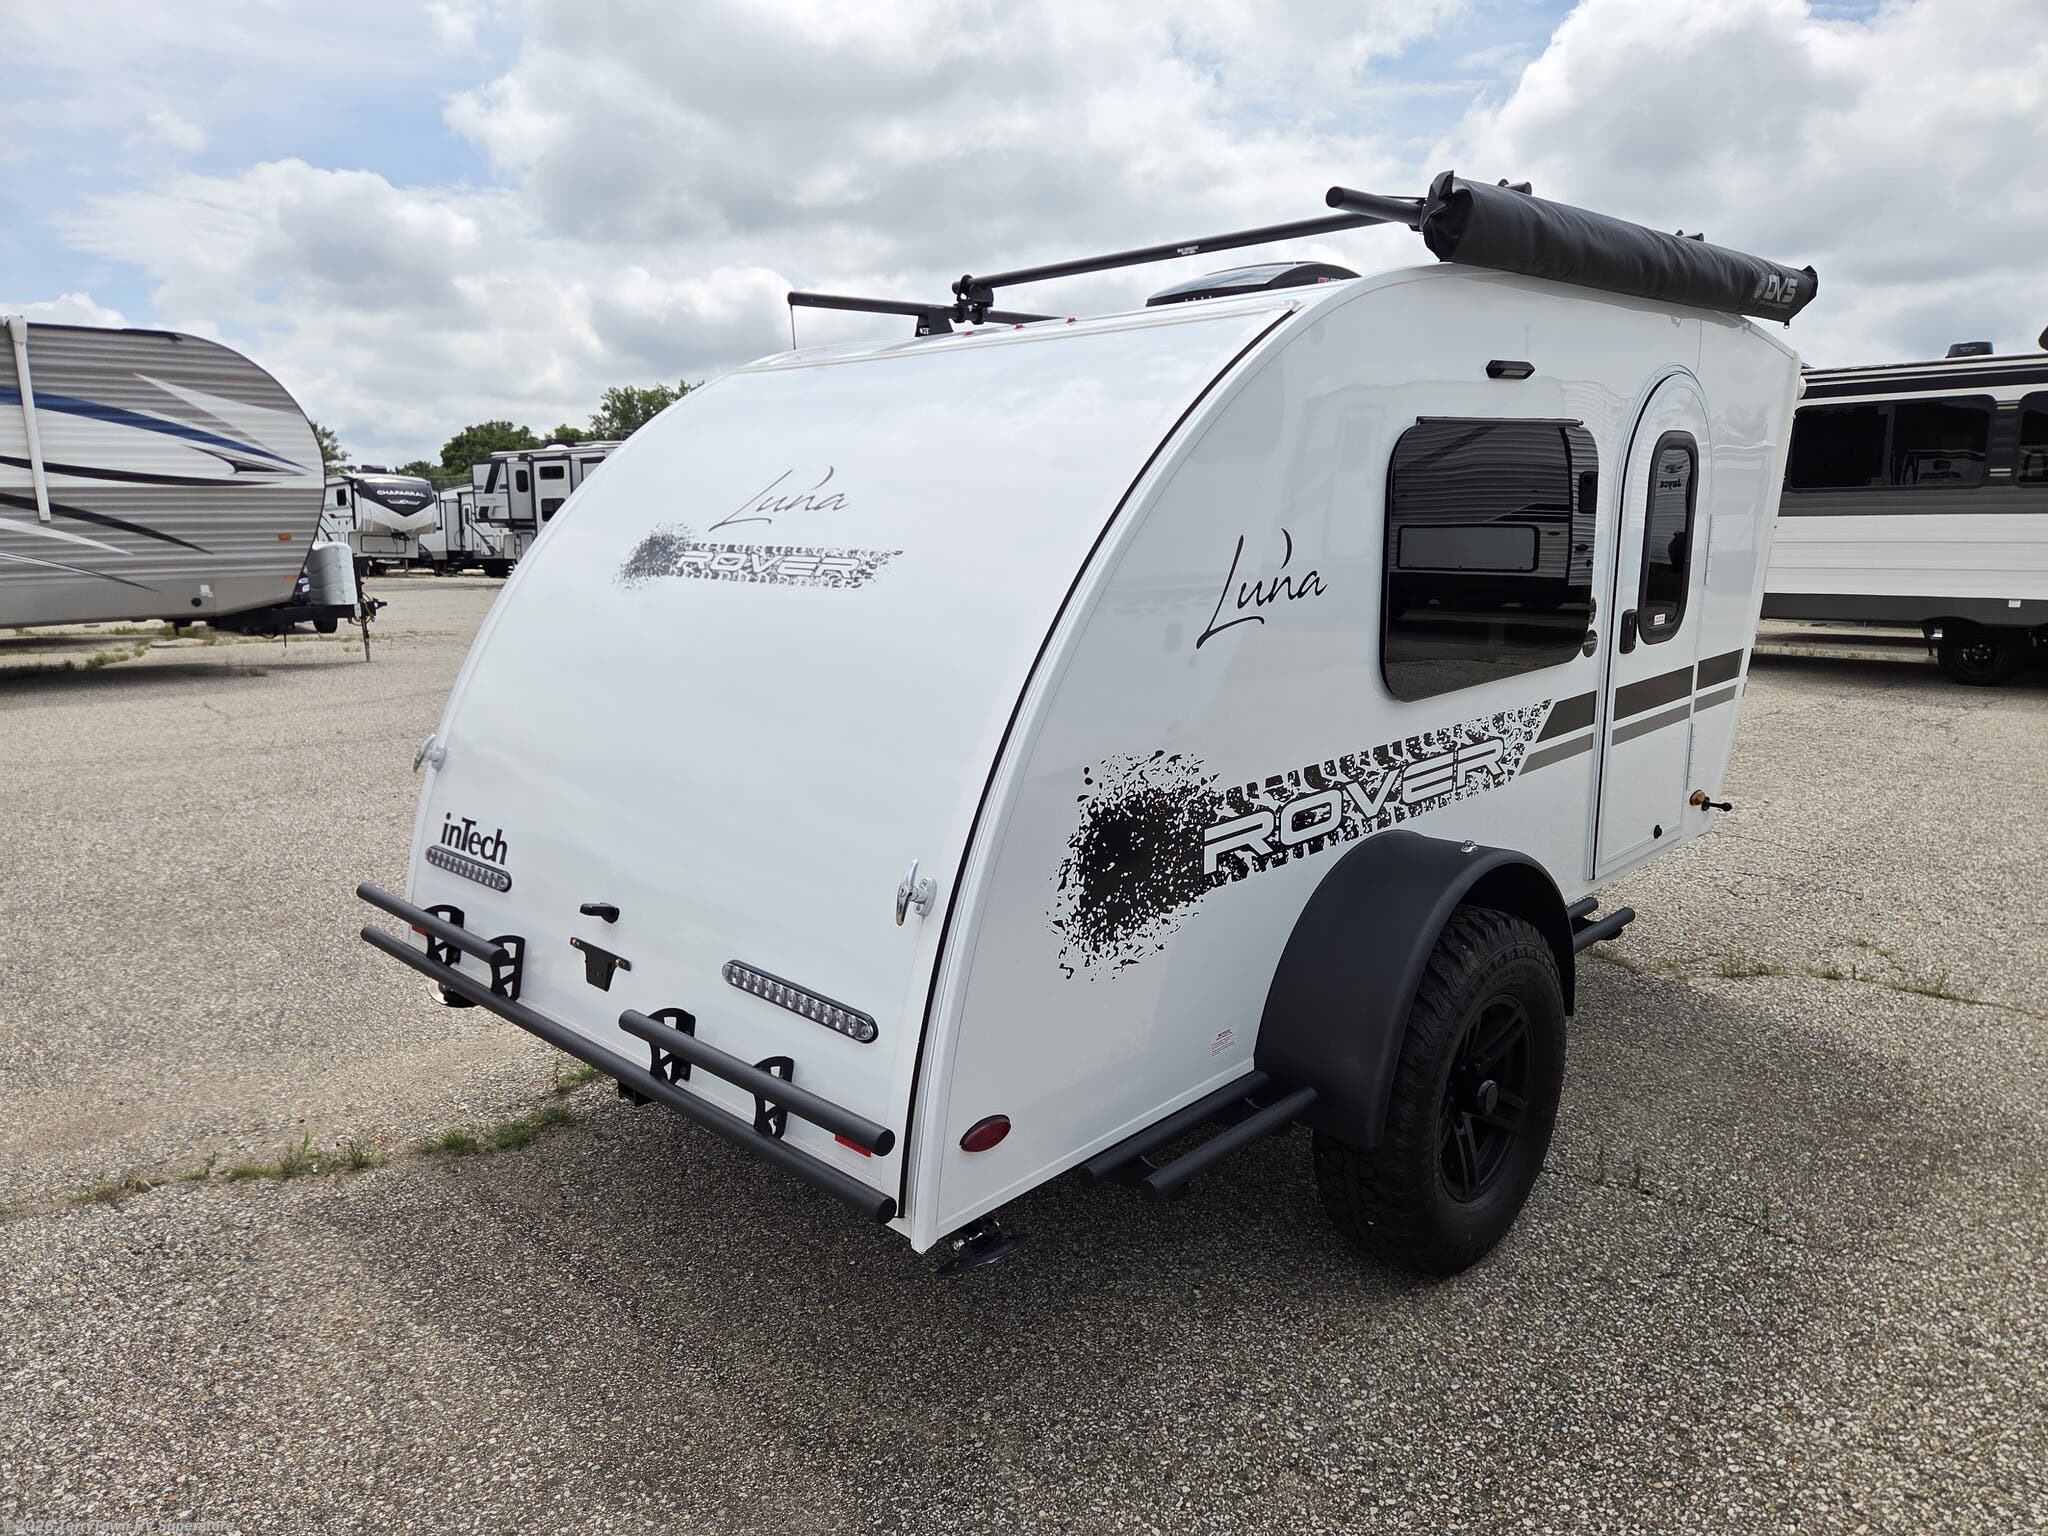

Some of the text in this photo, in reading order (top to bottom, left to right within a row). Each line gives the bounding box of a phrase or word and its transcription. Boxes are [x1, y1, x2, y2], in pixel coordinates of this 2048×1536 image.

[376, 490, 427, 498] CHAPARRAL
[708, 466, 850, 532] Luna
[673, 550, 861, 580] ROVER
[1196, 528, 1328, 649] Luna
[1202, 738, 1505, 876] ROVER
[440, 811, 508, 866] inTech
